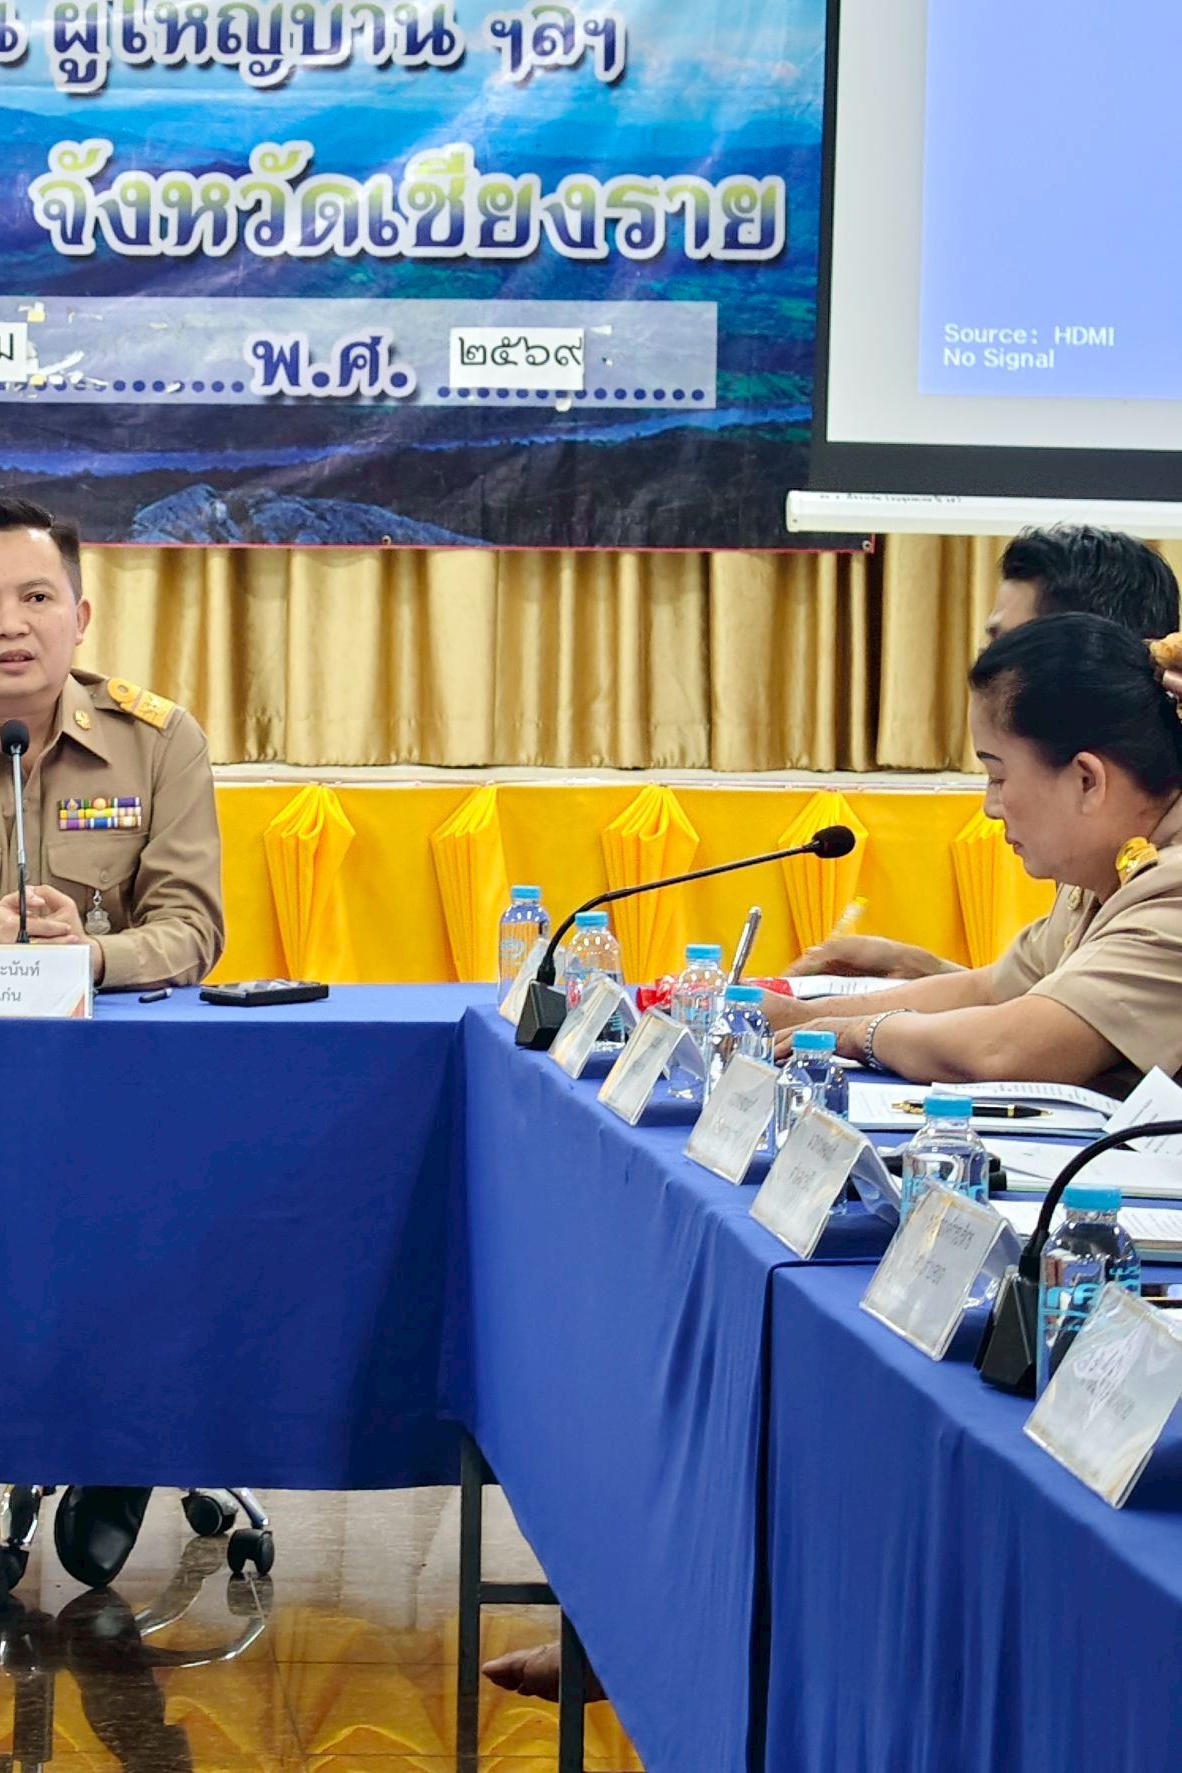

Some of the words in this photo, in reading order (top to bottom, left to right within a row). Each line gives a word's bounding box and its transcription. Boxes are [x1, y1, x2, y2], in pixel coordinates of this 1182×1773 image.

[484, 0, 625, 82] ฯลฯ
[30, 138, 786, 260] จังหวัดเชียงราย
[245, 327, 417, 398] พ.ศ.
[458, 335, 583, 367] ๒๕๖๙
[942, 347, 976, 368] No
[983, 349, 1056, 370] Signal
[943, 323, 1039, 346] Source:
[1054, 326, 1115, 347] HDMI
